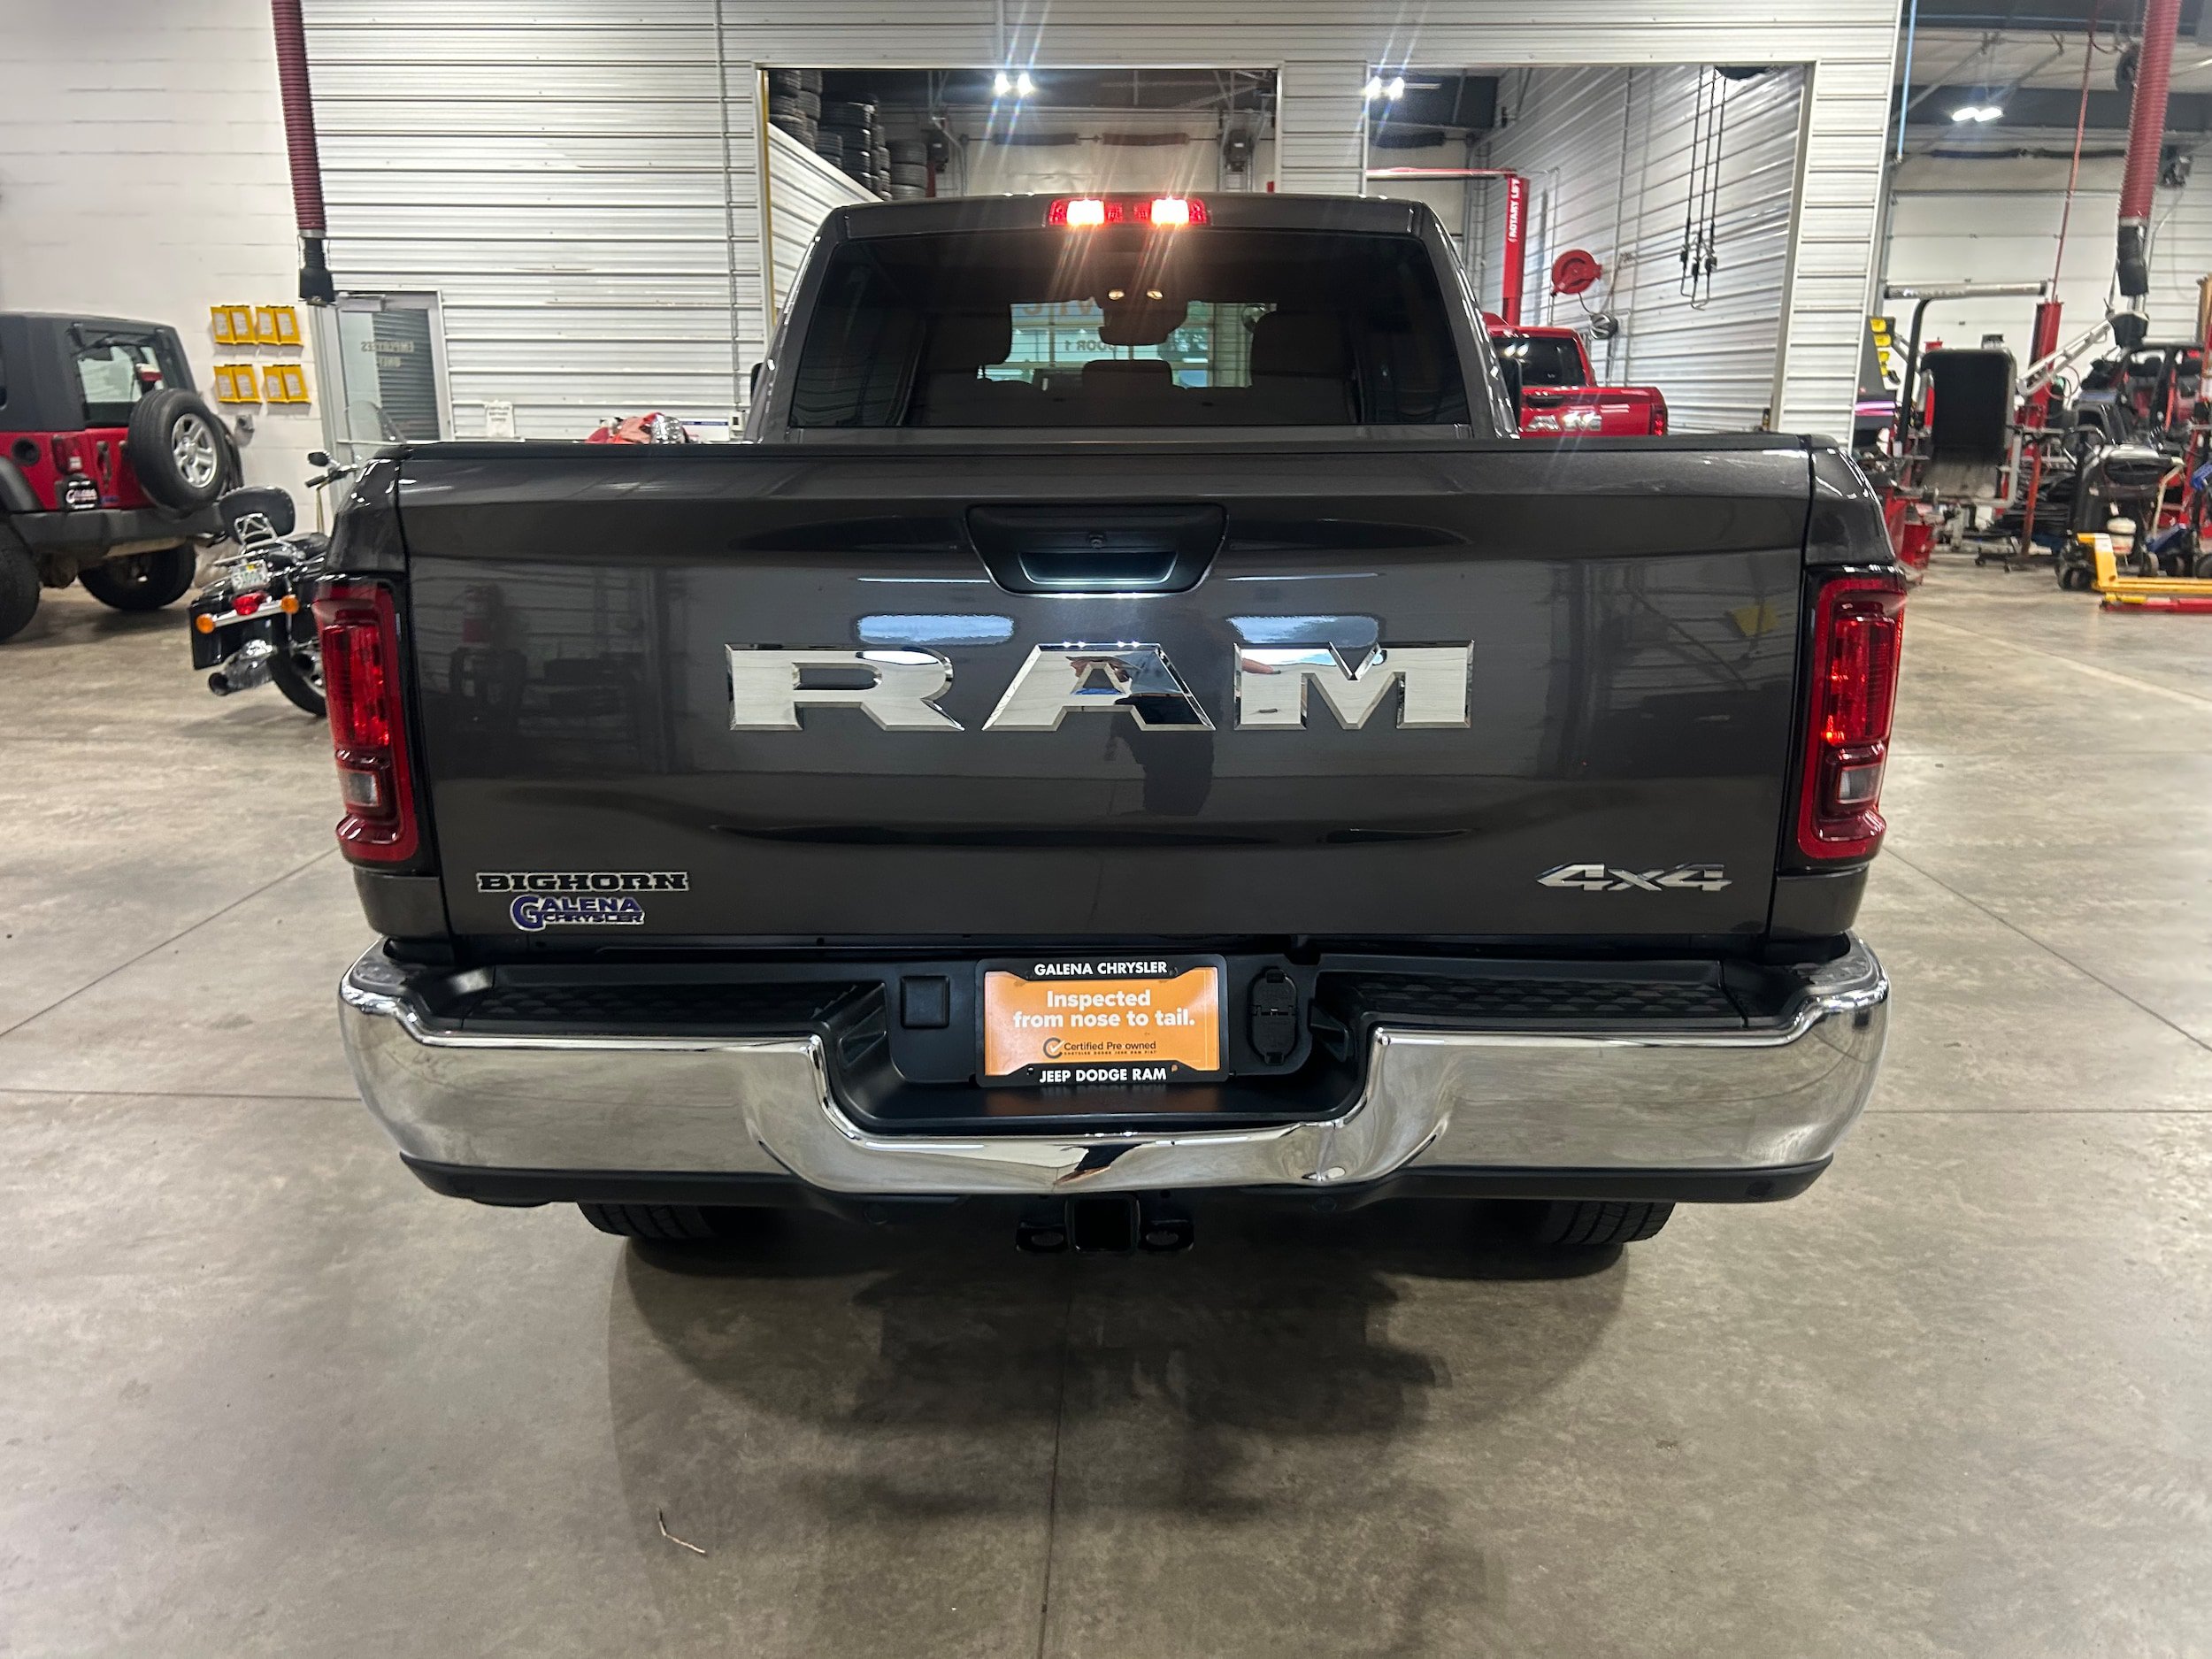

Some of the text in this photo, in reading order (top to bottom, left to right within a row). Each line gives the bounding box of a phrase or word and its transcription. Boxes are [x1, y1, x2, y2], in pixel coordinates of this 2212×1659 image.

[1509, 178, 1521, 237] ROTARY LIFT
[724, 641, 1475, 732] RAM
[476, 872, 689, 892] BIGHORN
[1537, 862, 1732, 891] 4x4
[510, 895, 643, 932] GALENA
[541, 911, 644, 924] CHRYSLER
[1034, 961, 1167, 976] GALENA CHRYSLER
[1047, 989, 1151, 1011] Inspected
[1013, 1009, 1194, 1028] from nose to tail.
[1064, 1041, 1104, 1051] Certified
[1039, 1067, 1167, 1083] JEEP DODGE RAM
